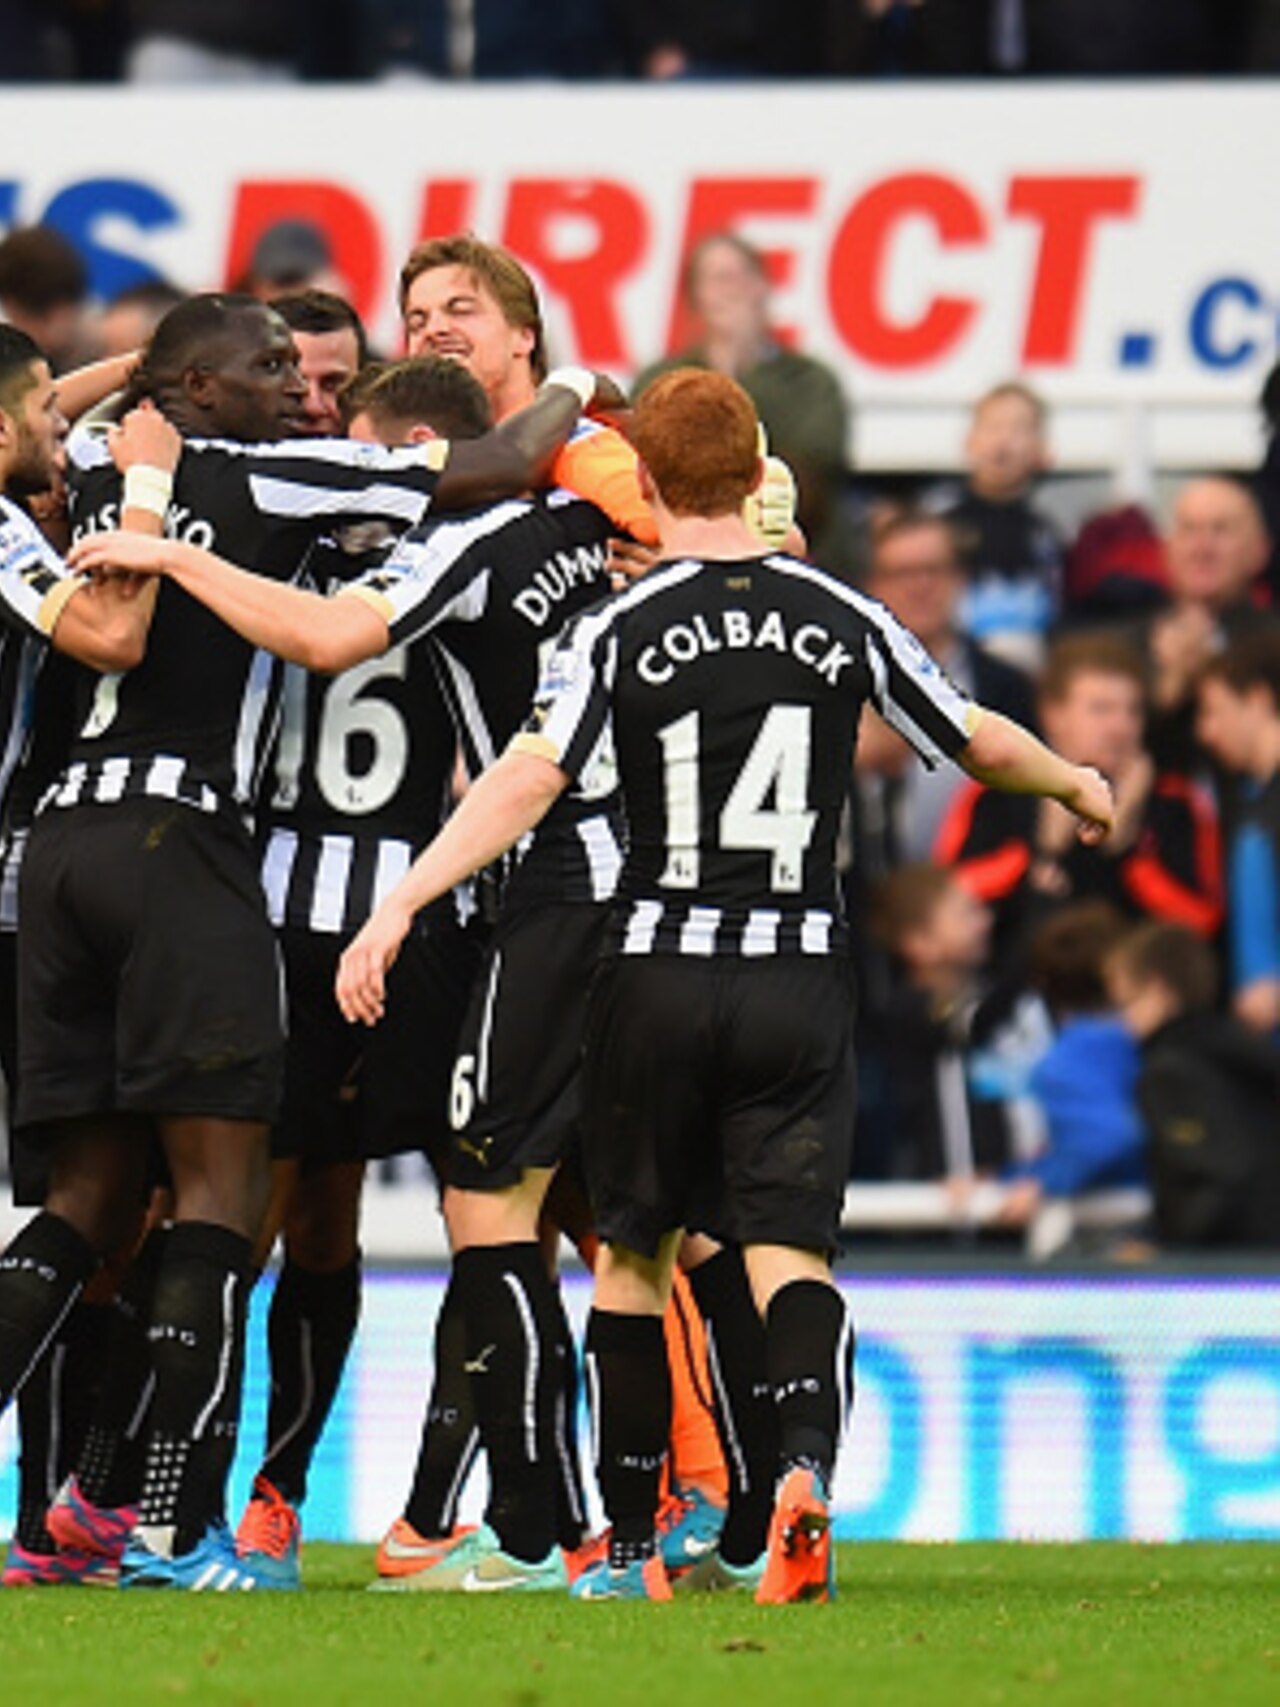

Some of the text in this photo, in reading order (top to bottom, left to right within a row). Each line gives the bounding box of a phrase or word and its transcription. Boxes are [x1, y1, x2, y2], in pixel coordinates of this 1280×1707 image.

[511, 542, 612, 627] DUMM
[637, 611, 853, 685] COLBACK
[657, 704, 818, 893] 14
[449, 1055, 475, 1131] 6
